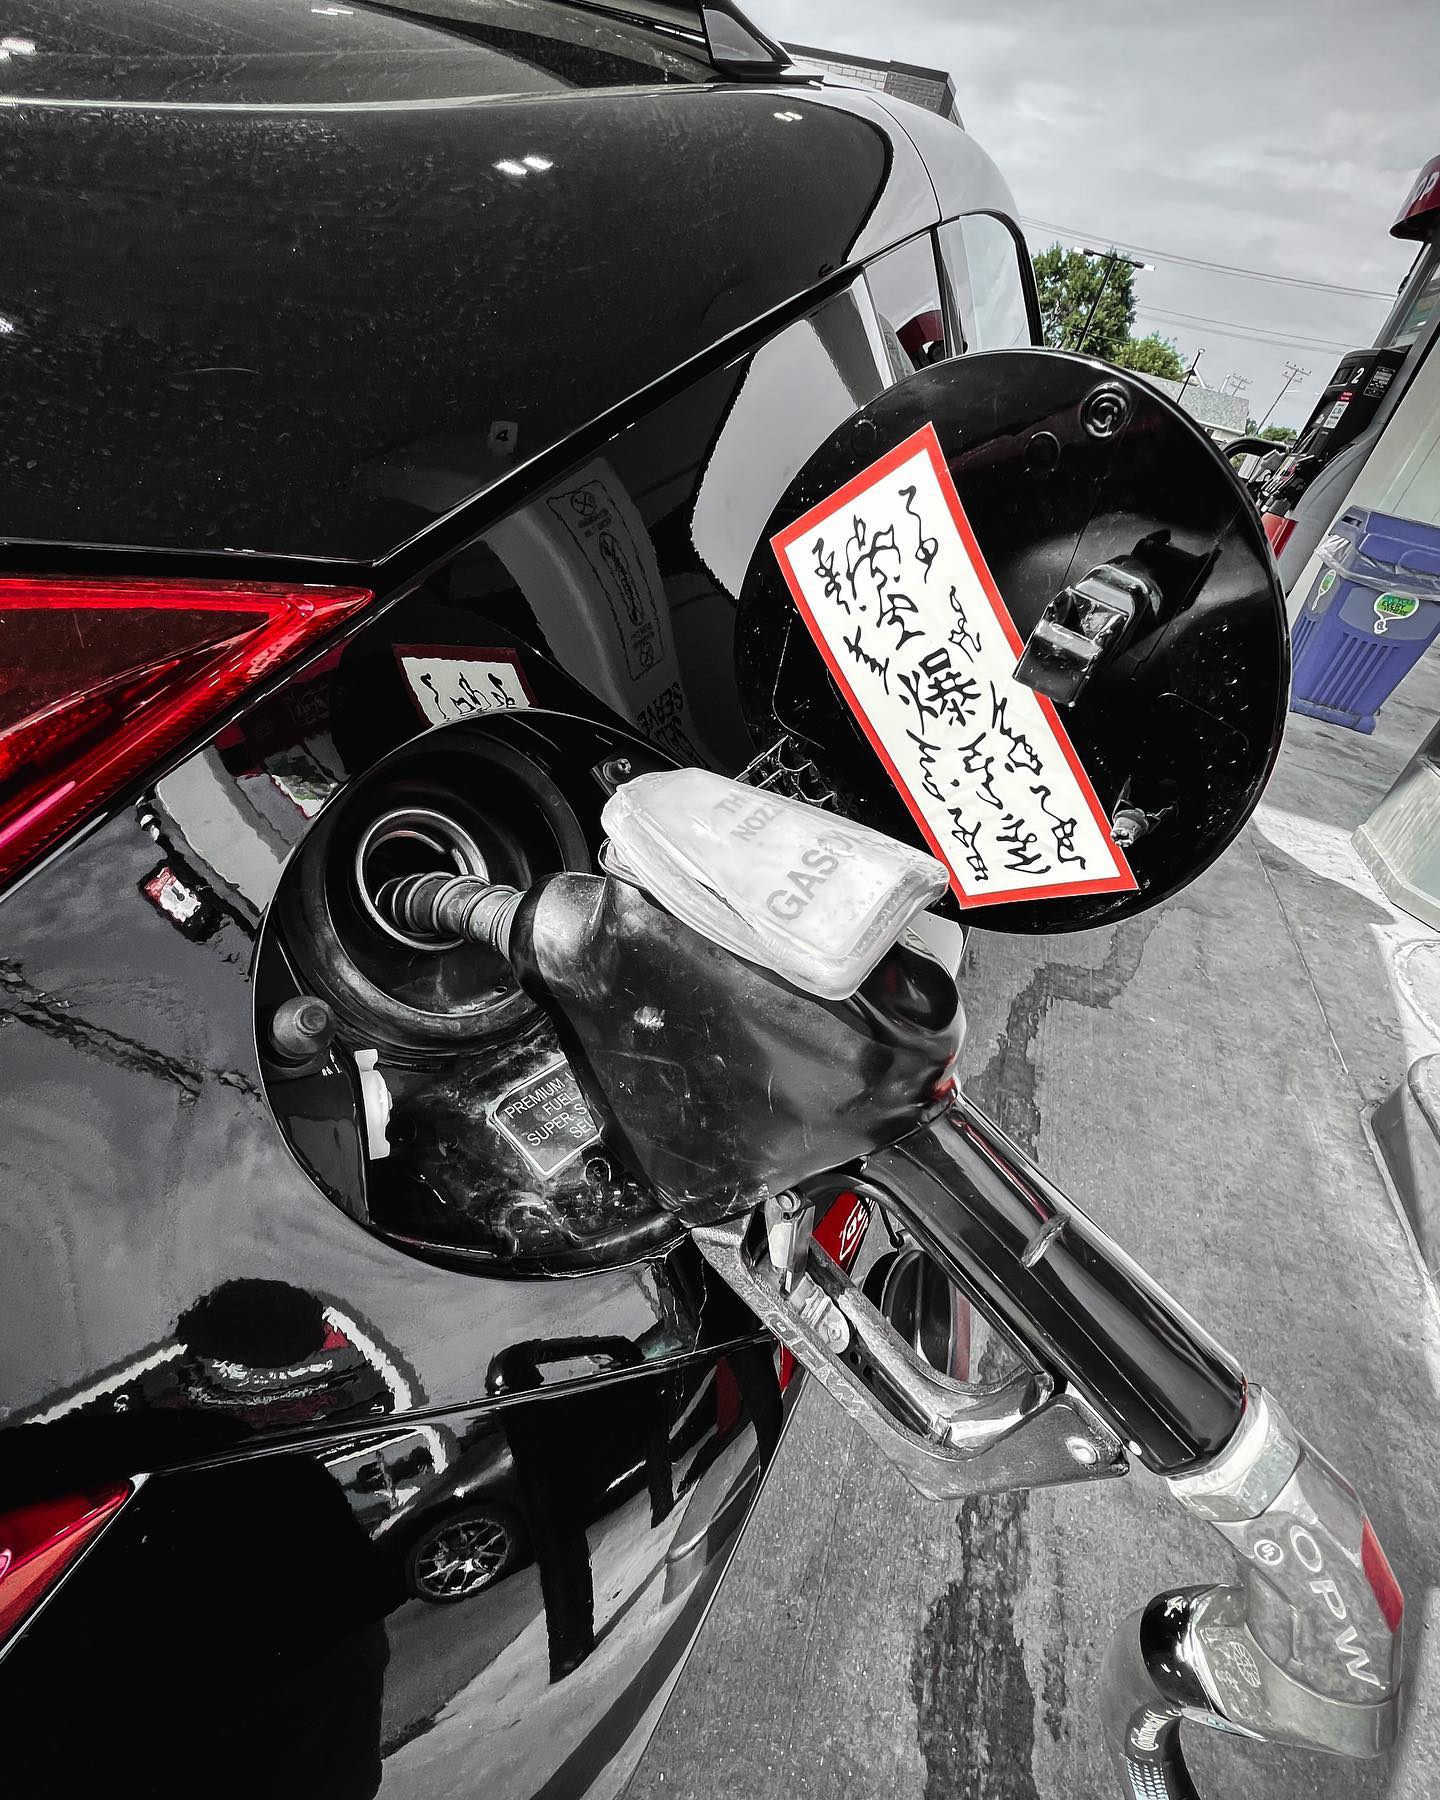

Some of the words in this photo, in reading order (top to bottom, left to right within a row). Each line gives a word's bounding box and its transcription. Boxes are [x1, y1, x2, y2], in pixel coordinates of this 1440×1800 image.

[1351, 367, 1365, 385] 2
[503, 1077, 566, 1119] PREMIUM
[541, 1092, 577, 1116] FUEL
[527, 1111, 576, 1147] SUPER
[1289, 1525, 1386, 1690] OPW
